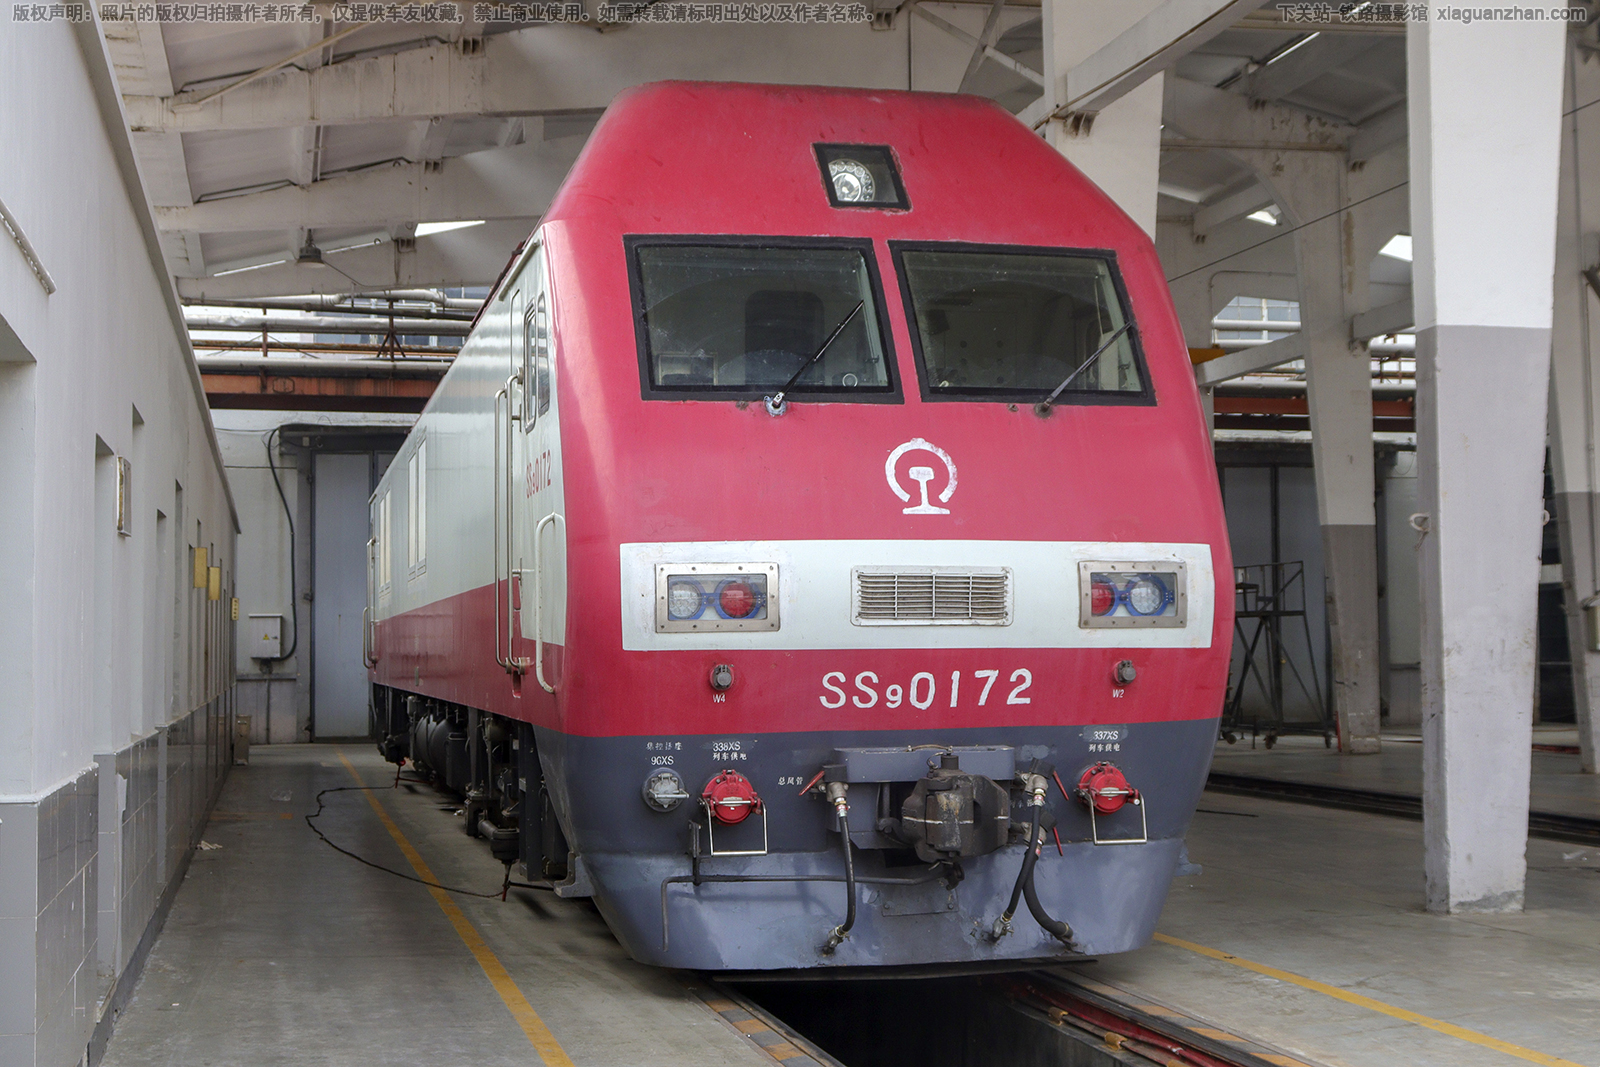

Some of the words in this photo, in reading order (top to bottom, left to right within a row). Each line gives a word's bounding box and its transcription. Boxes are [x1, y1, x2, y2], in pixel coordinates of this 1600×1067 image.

[1112, 689, 1125, 698] W2
[712, 694, 726, 703] W4
[1093, 731, 1119, 740] 337XS
[712, 741, 741, 752] 338XS
[1088, 743, 1121, 752] 列车供电
[777, 776, 804, 786] 总风管
